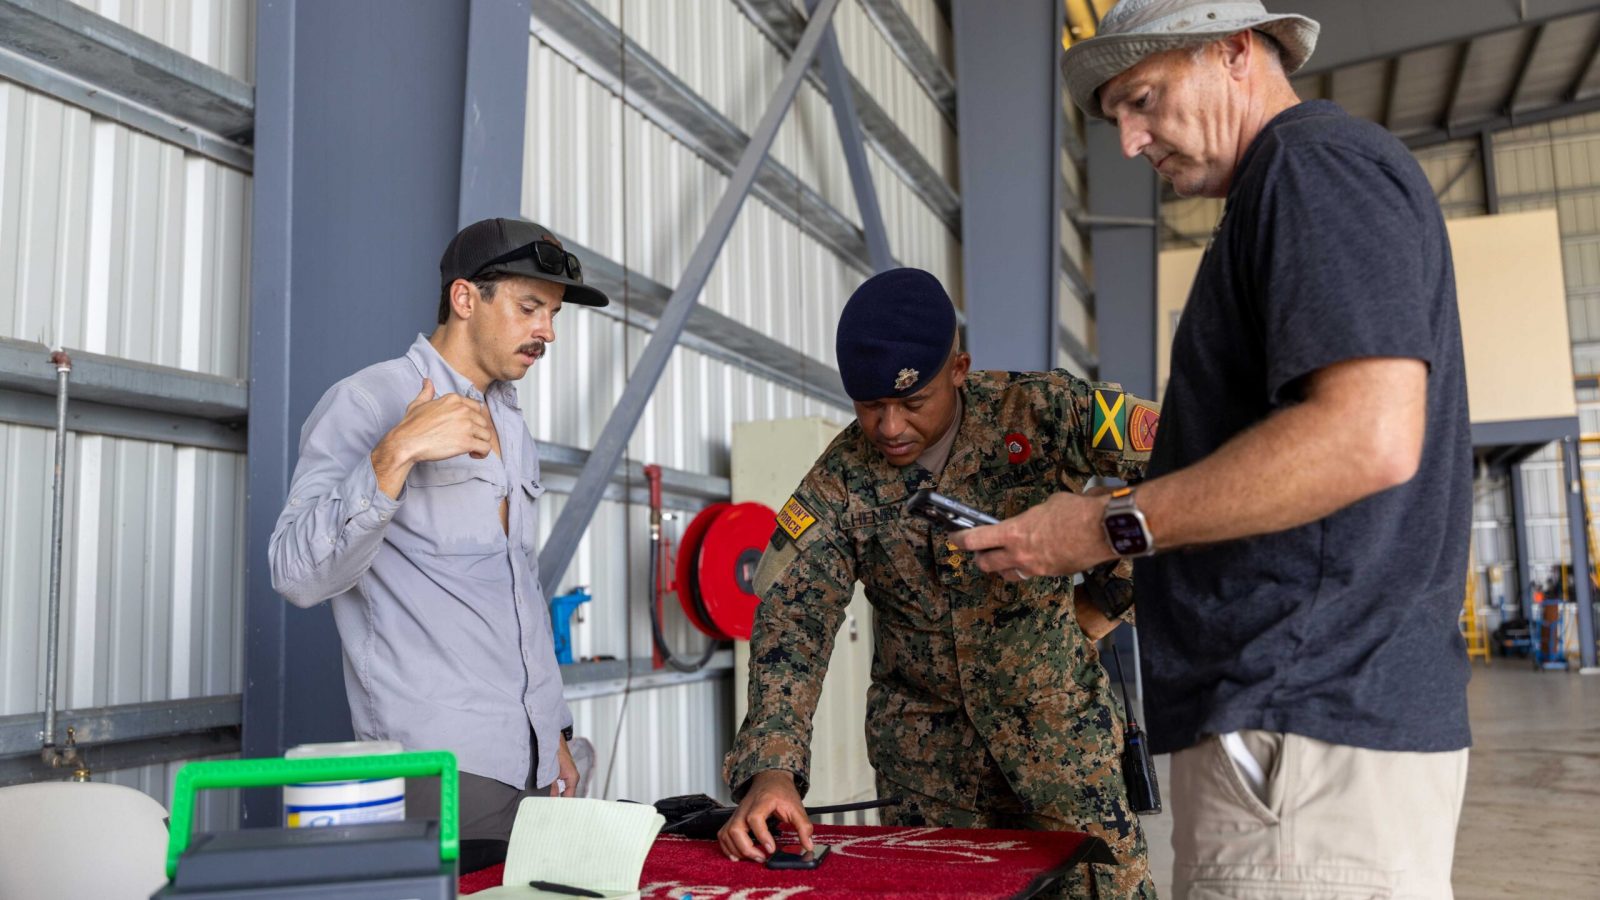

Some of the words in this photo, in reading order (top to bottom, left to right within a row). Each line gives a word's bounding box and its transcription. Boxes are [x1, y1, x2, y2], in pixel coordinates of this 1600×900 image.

[779, 510, 802, 534] FORCE
[789, 501, 809, 521] JOINT
[851, 503, 902, 527] HENRY
